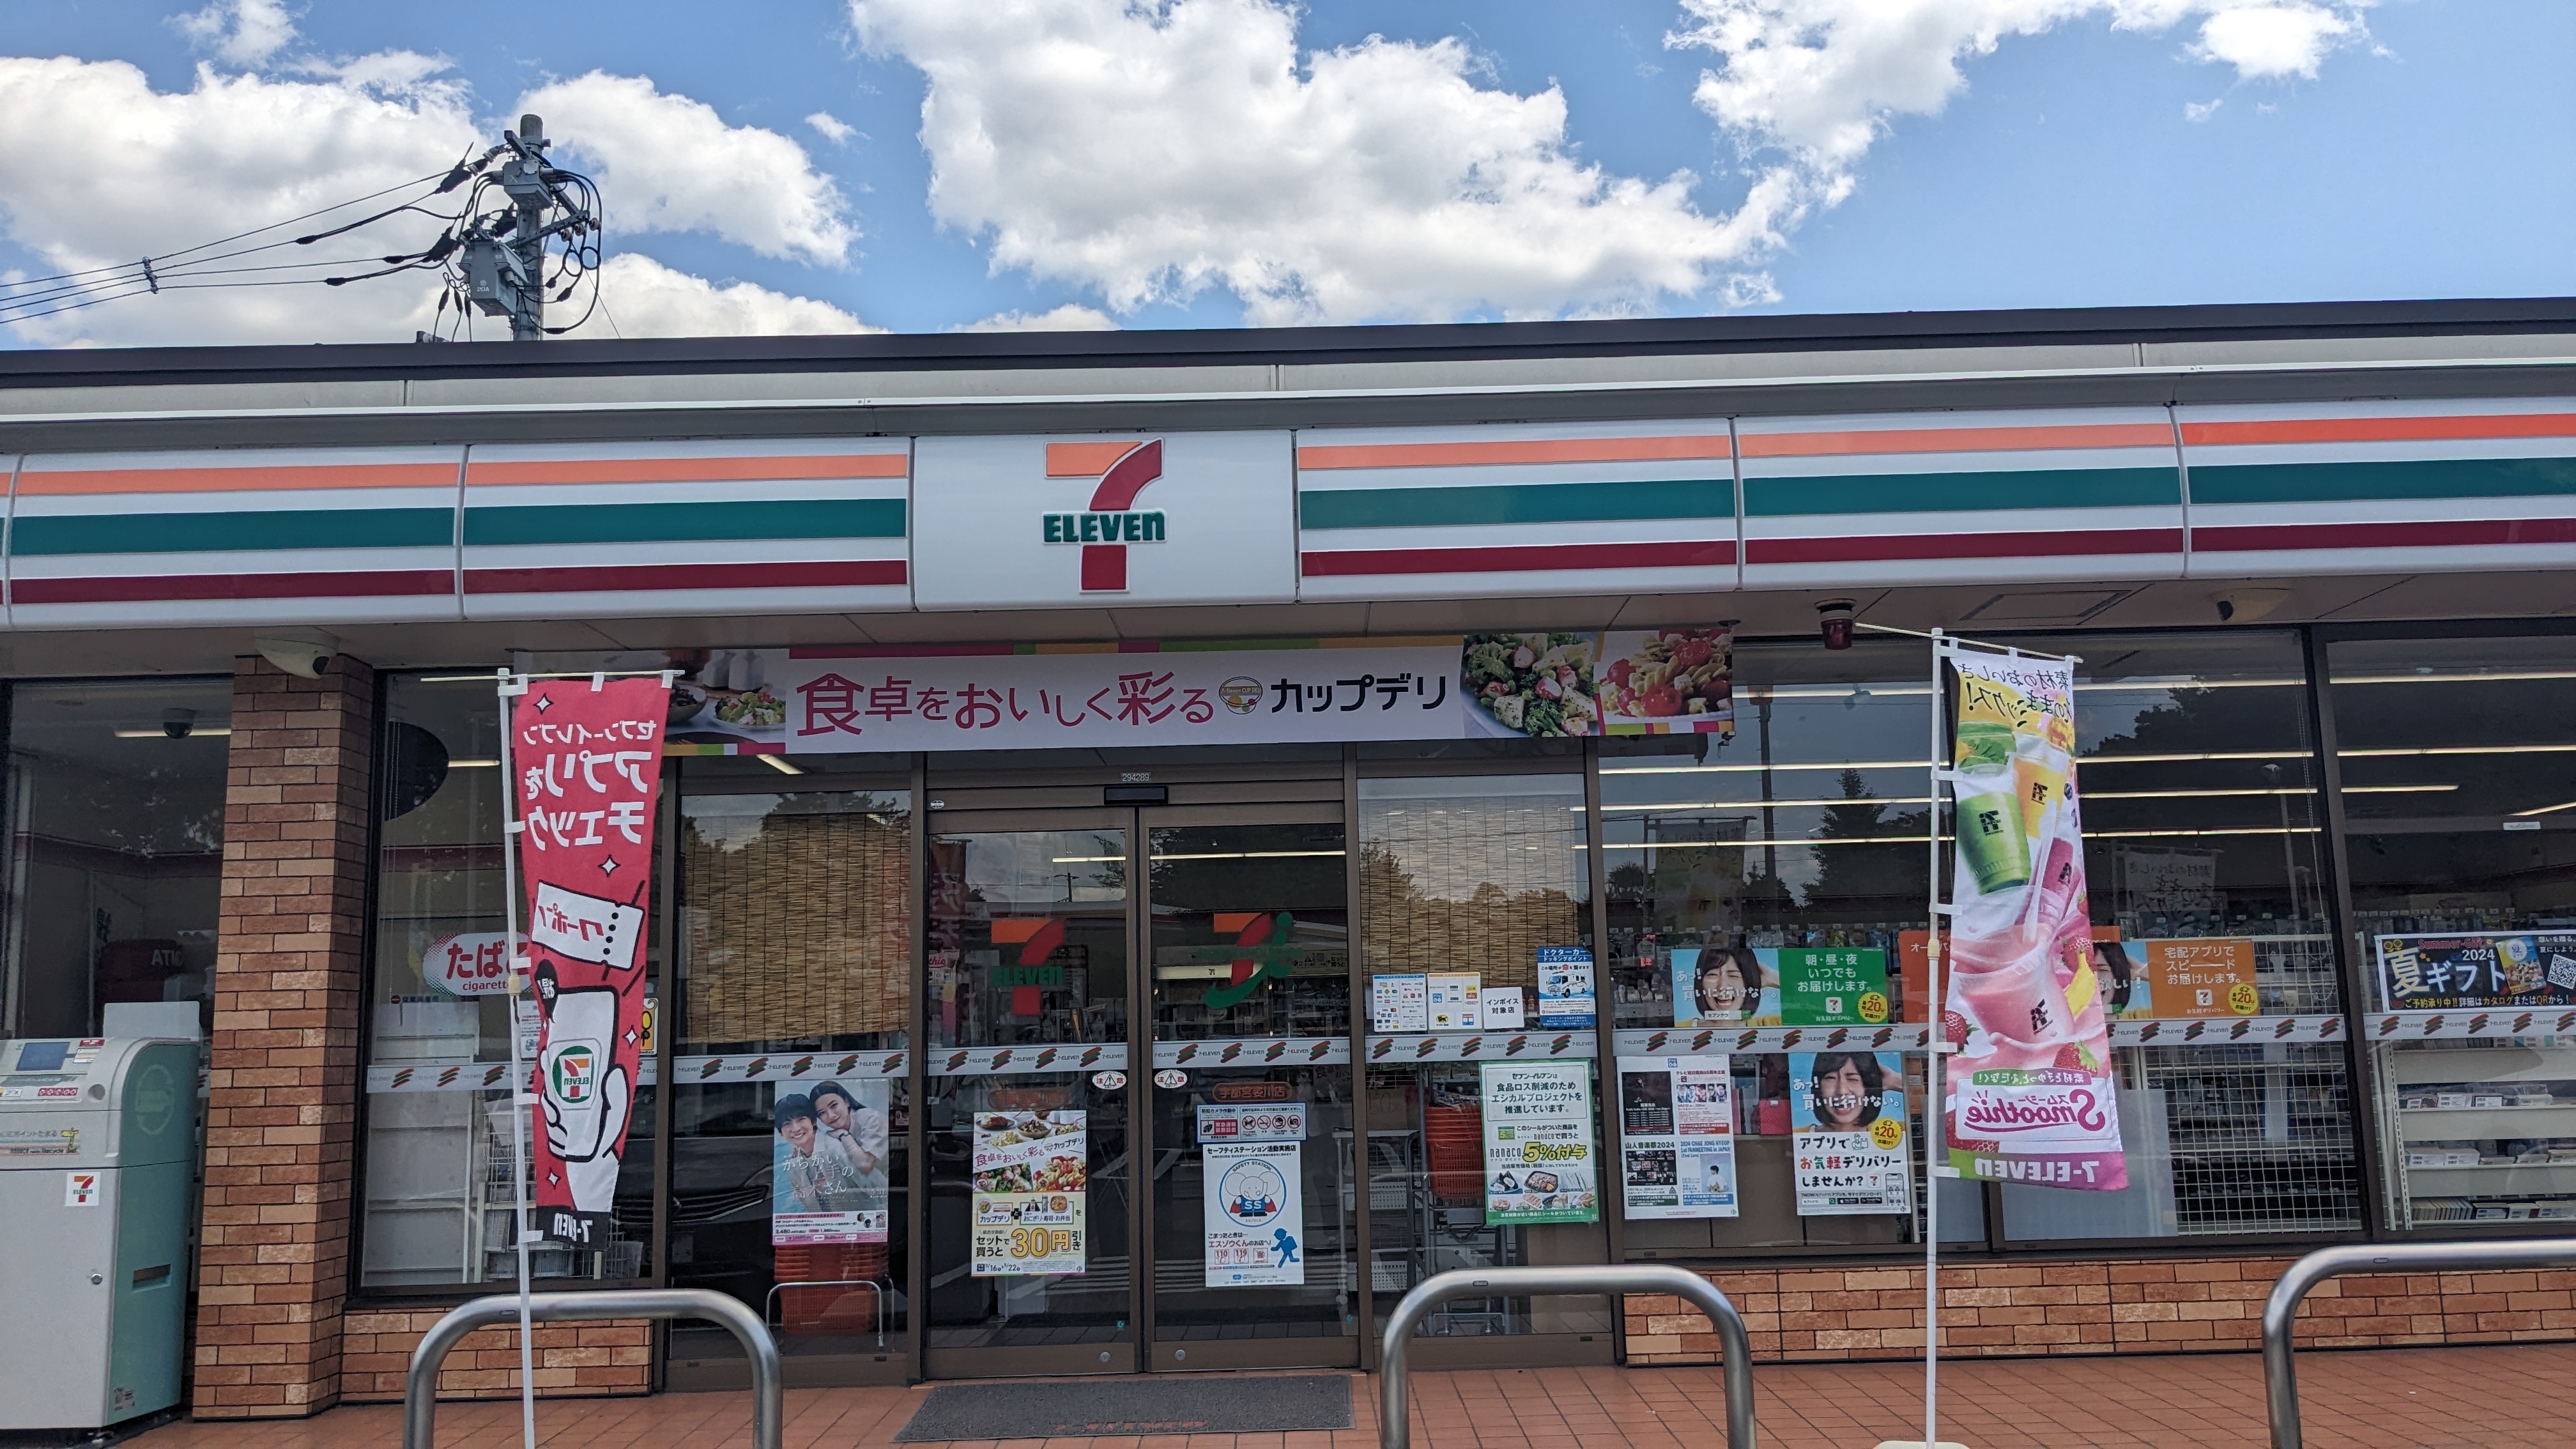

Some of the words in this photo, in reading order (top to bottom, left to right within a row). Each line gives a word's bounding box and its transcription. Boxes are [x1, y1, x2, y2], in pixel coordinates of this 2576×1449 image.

[1043, 511, 1165, 542] ELEVEN
[1270, 672, 1446, 716] カップデリ
[796, 670, 1215, 737] 食卓をおいしく彩る
[1123, 773, 1149, 782] 294289
[2164, 946, 2235, 958] 宅配アプリで
[2462, 949, 2496, 962] 2024
[1805, 954, 1858, 966] 朝・昼・夜
[993, 965, 1063, 986] ELEVEN
[1808, 967, 1857, 979] いつでも
[2166, 972, 2241, 986] お届けします。
[463, 981, 510, 992] cigarett
[1797, 980, 1872, 993] お届けします。
[1496, 1082, 1576, 1092] 食品ロス削減のため
[1793, 1076, 1820, 1091] あっ!
[1492, 1092, 1583, 1103] エシカルプロジェクトを
[1802, 1094, 1900, 1110] 買いに行けない。
[1505, 1104, 1569, 1114] 推進しています。
[1054, 1137, 1084, 1150] カップデリ
[1625, 1141, 1675, 1149] 山人音楽祭2024
[1800, 1137, 1850, 1150] アプリで
[975, 1146, 1045, 1167] 食卓をおいしく彩る
[1490, 1147, 1521, 1158] nanaco
[1522, 1142, 1587, 1162] 5%付与
[1232, 1162, 1251, 1172] SAFETY
[1251, 1161, 1272, 1171] STATION
[1800, 1155, 1901, 1170] お気軽デリバリー
[1802, 1176, 1864, 1188] しませんか?
[976, 1236, 1010, 1245] セットで
[1010, 1227, 1071, 1259] 30円
[976, 1246, 1003, 1257] 買うと
